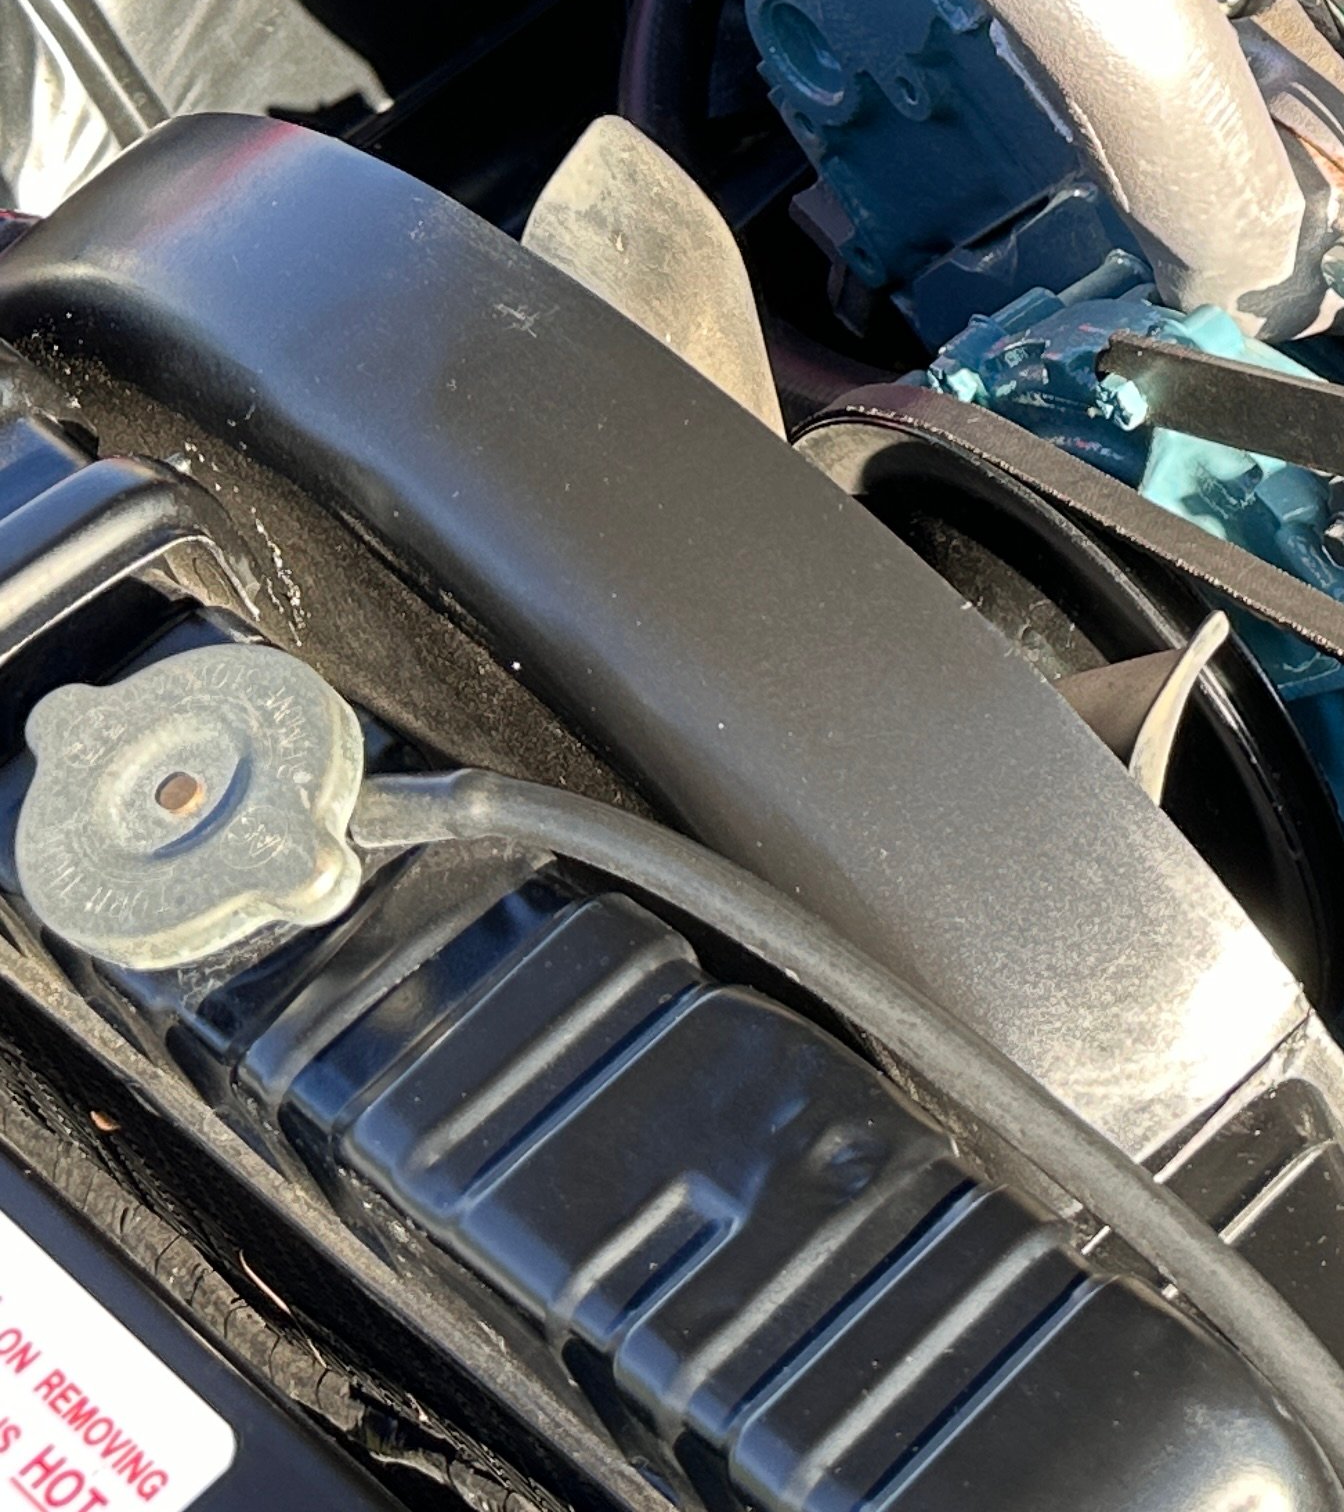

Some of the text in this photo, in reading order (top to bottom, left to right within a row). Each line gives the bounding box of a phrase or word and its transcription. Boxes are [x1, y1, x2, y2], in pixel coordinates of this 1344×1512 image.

[0, 1326, 169, 1502] ON REMOVING
[18, 1443, 109, 1512] HOT
